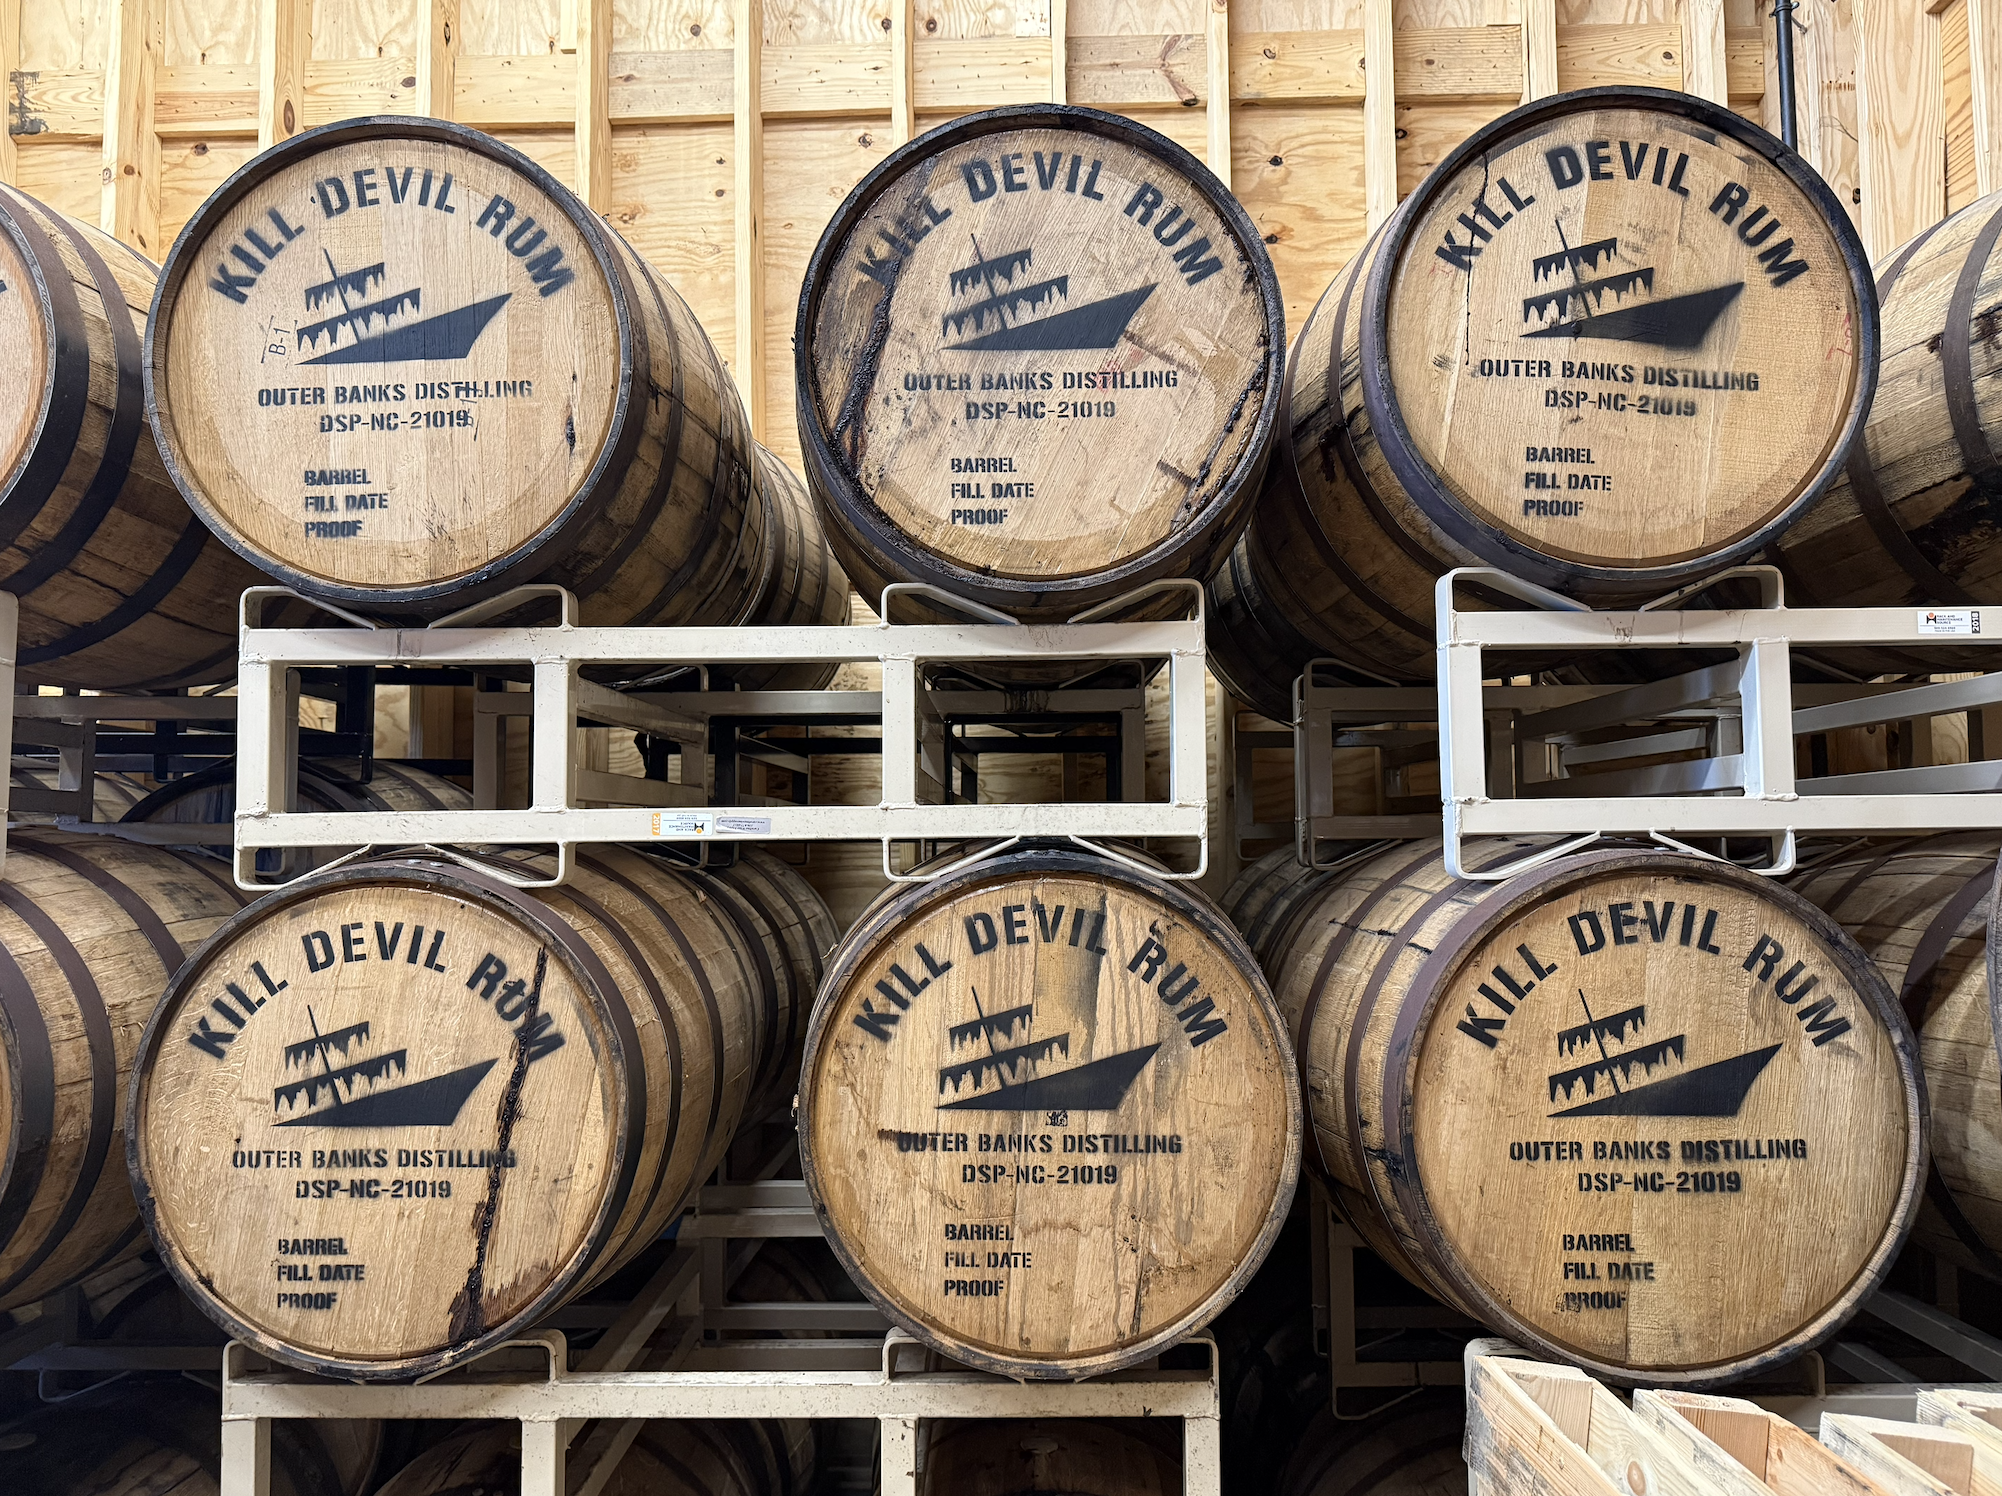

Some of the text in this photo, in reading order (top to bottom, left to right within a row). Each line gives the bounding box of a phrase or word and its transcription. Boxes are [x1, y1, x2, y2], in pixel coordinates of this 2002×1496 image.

[856, 150, 1223, 287] KILL DEVIL RUM
[1435, 177, 1536, 272] KILL
[1545, 140, 1690, 197] DEVIL
[1709, 181, 1810, 288] RUM
[208, 166, 575, 305] KILL DEVIL RUM
[268, 327, 290, 356] B-1
[904, 370, 1178, 391] OUTER BANKS DISTILLING
[1480, 358, 1759, 392] OUTER BANKS DISTILLING
[258, 380, 532, 408] OUTER BANKS DISTILLING
[1545, 390, 1696, 417] DSP-NC-21019
[965, 401, 1116, 420] DSP-NC-21019
[320, 411, 470, 433] DSP-NC-21019
[951, 457, 1017, 473] BARREL
[1526, 447, 1595, 465] BARREL
[304, 470, 371, 487] BARREL
[1525, 474, 1612, 491] FILL DATE
[951, 482, 1034, 498] FILL DATE
[304, 494, 388, 512] FILL DATE
[1524, 499, 1584, 517] PROOF
[951, 509, 1008, 525] PROOF
[304, 521, 363, 538] PROOF
[1972, 612, 1980, 632] 2018
[852, 903, 1229, 1048] KILL DEVIL RUM
[1456, 900, 1853, 1050] KILL DEVIL RUM
[188, 921, 566, 1064] KILL DEVIL RUM
[897, 1132, 1182, 1154] OUTER BANKS DISTILLING
[1509, 1138, 1807, 1161] OUTER BANKS DISTILLING
[232, 1149, 516, 1169] OUTER BANKS DISTILLING
[962, 1164, 1118, 1185] DSP-NC-21019
[1578, 1170, 1742, 1193] DSP-NC-21019
[296, 1179, 452, 1199] DSP-NC-21019
[945, 1223, 1015, 1241] BARREL
[277, 1238, 348, 1255] BARREL
[1562, 1233, 1635, 1252] BARREL
[945, 1251, 1032, 1269] FILL DATE
[277, 1264, 365, 1282] FILL DATE
[1563, 1261, 1655, 1282] FILL DATE
[944, 1279, 1005, 1297] PROOF
[277, 1292, 338, 1309] PROOF
[1563, 1290, 1629, 1311] PROOF
